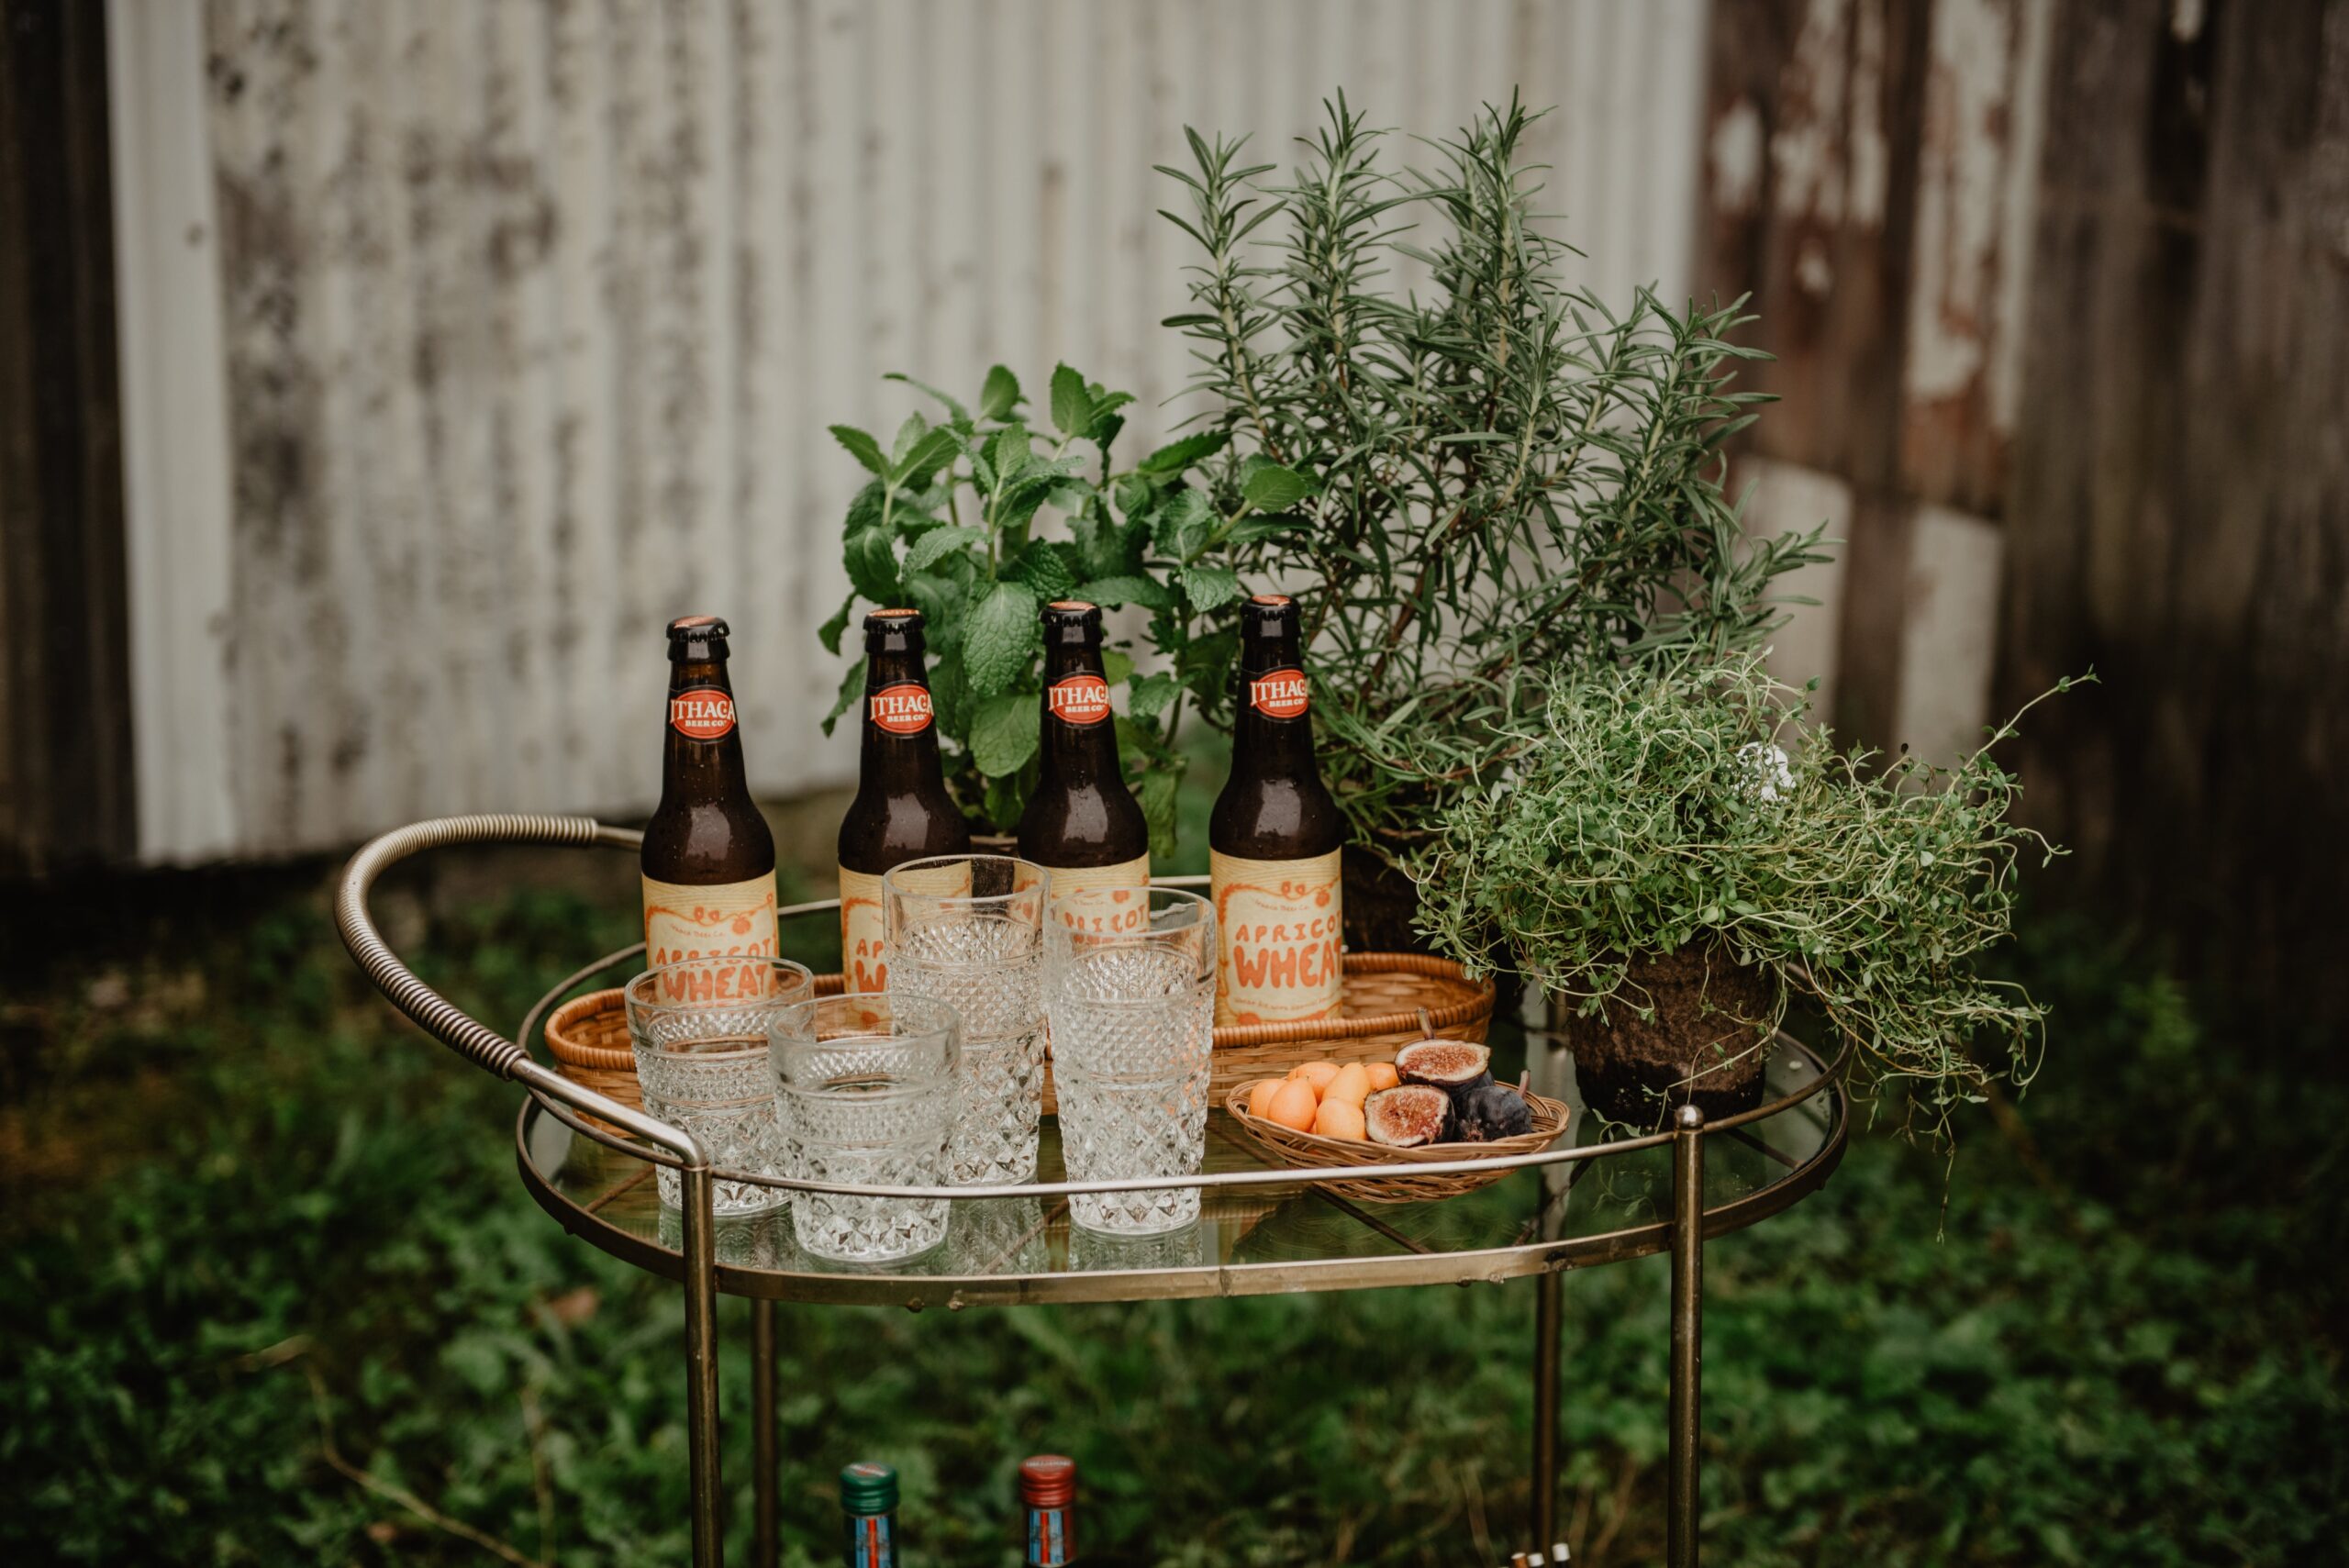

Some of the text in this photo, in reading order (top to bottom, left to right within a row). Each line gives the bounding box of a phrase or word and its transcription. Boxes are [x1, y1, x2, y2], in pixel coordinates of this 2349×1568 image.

[670, 699, 736, 724] ITHACA
[870, 694, 935, 721] ITHACA
[1064, 705, 1090, 713] BEER
[1268, 699, 1293, 707] BEER
[685, 719, 710, 728] BEER
[886, 714, 912, 723] BEER
[1235, 910, 1341, 943] APRICO
[662, 963, 768, 1002] WHEAT
